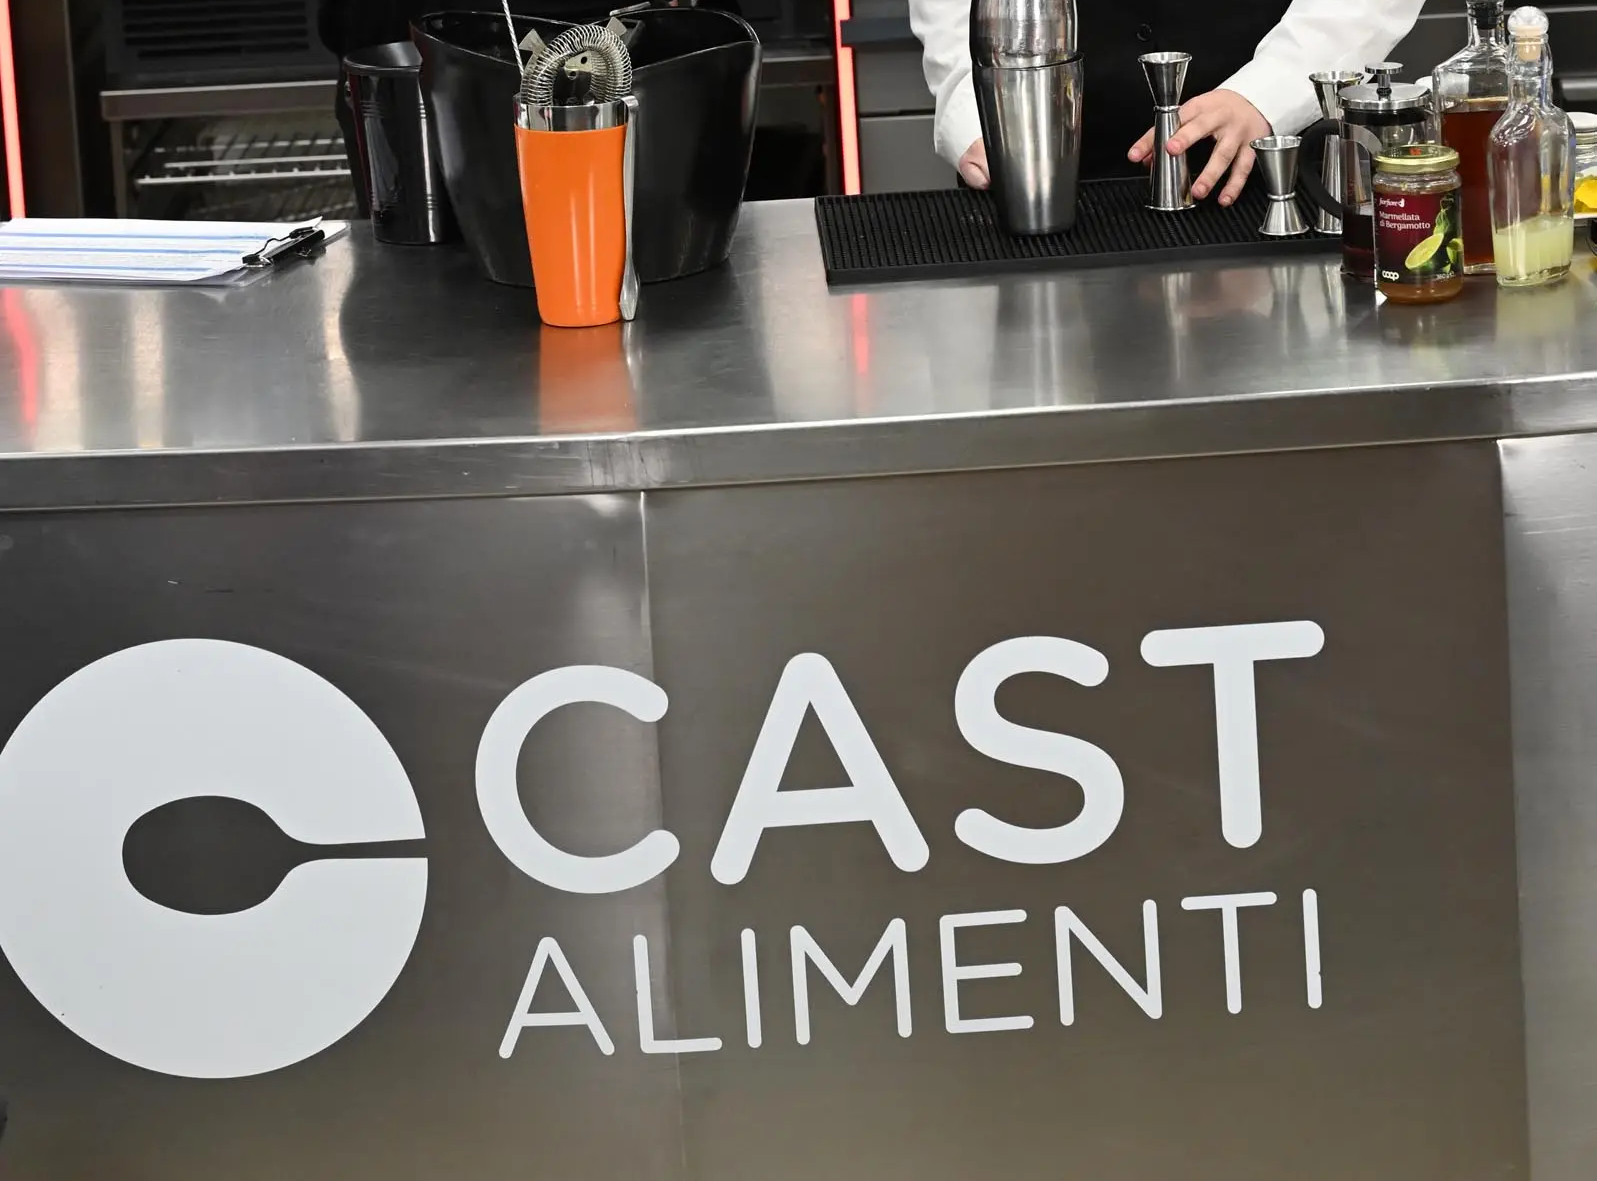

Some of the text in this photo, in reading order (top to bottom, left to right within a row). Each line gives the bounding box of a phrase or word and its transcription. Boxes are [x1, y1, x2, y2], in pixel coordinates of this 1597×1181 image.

[1379, 211, 1420, 220] Marmellata
[1386, 221, 1430, 230] Bergamotto
[1382, 270, 1399, 281] coop
[475, 620, 1325, 894] CAST
[498, 888, 1322, 1059] ALIMENTI
